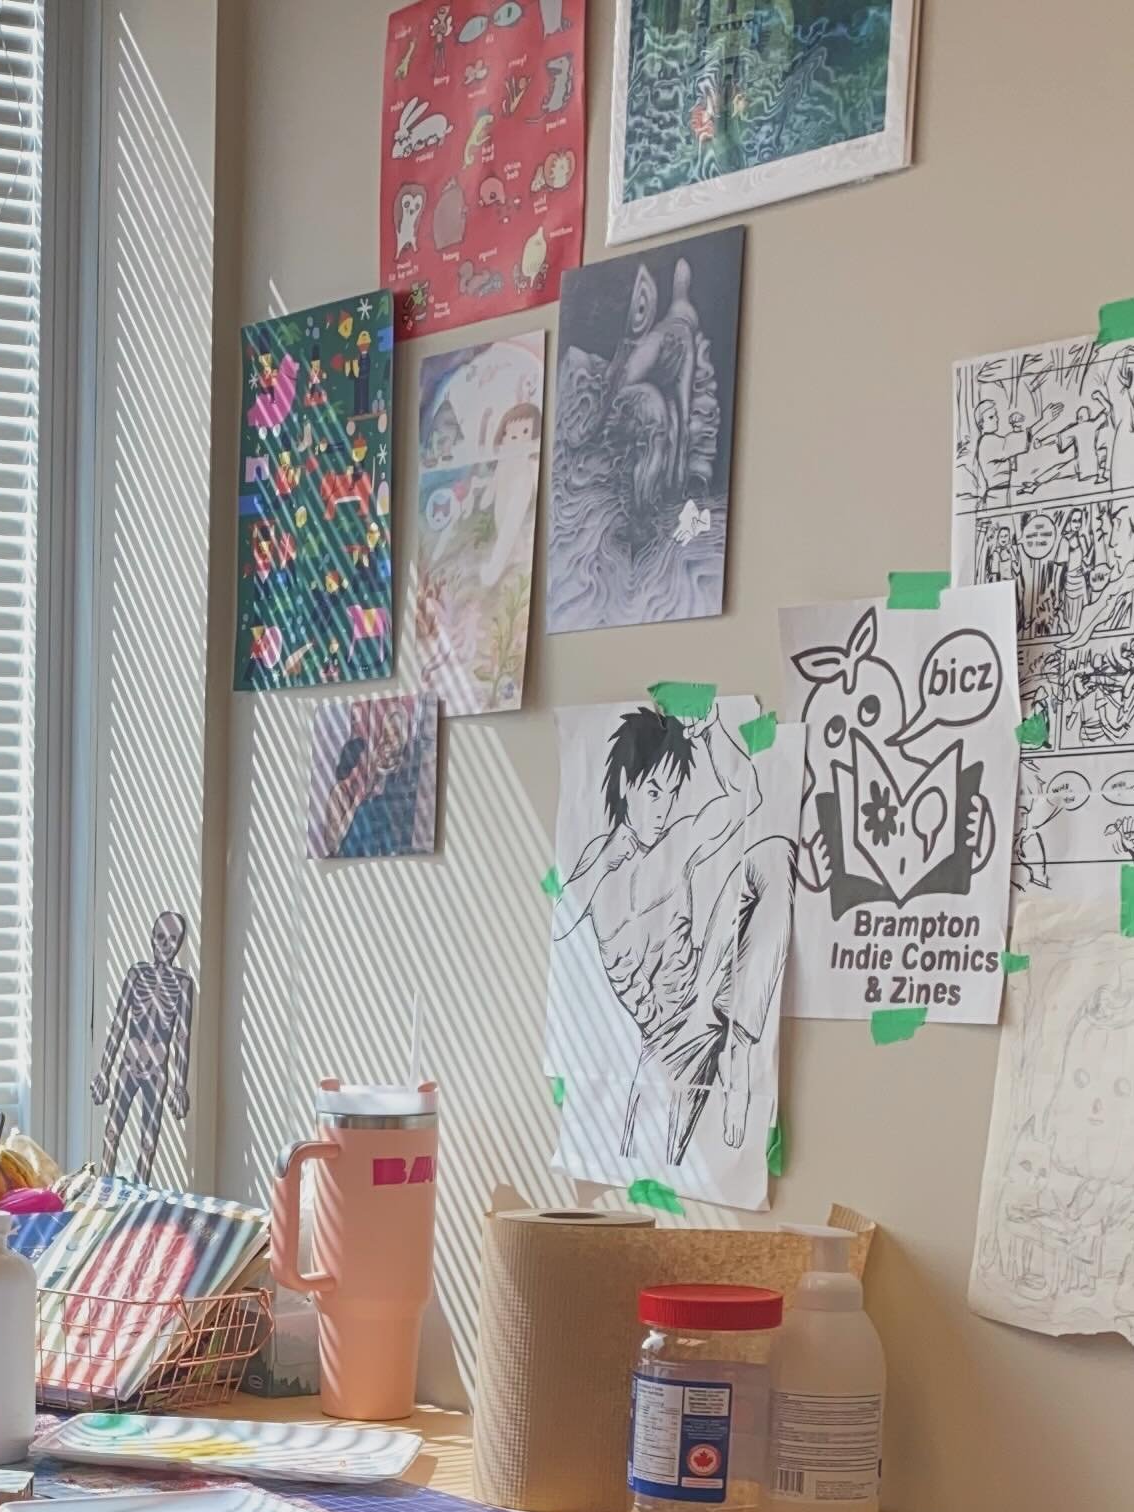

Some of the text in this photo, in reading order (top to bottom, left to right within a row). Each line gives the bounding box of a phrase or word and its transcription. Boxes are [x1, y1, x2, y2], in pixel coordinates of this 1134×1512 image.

[928, 658, 994, 696] bicz
[854, 910, 980, 943] Brampton
[831, 942, 999, 973] Indie Comics
[864, 976, 962, 1005] & Zines
